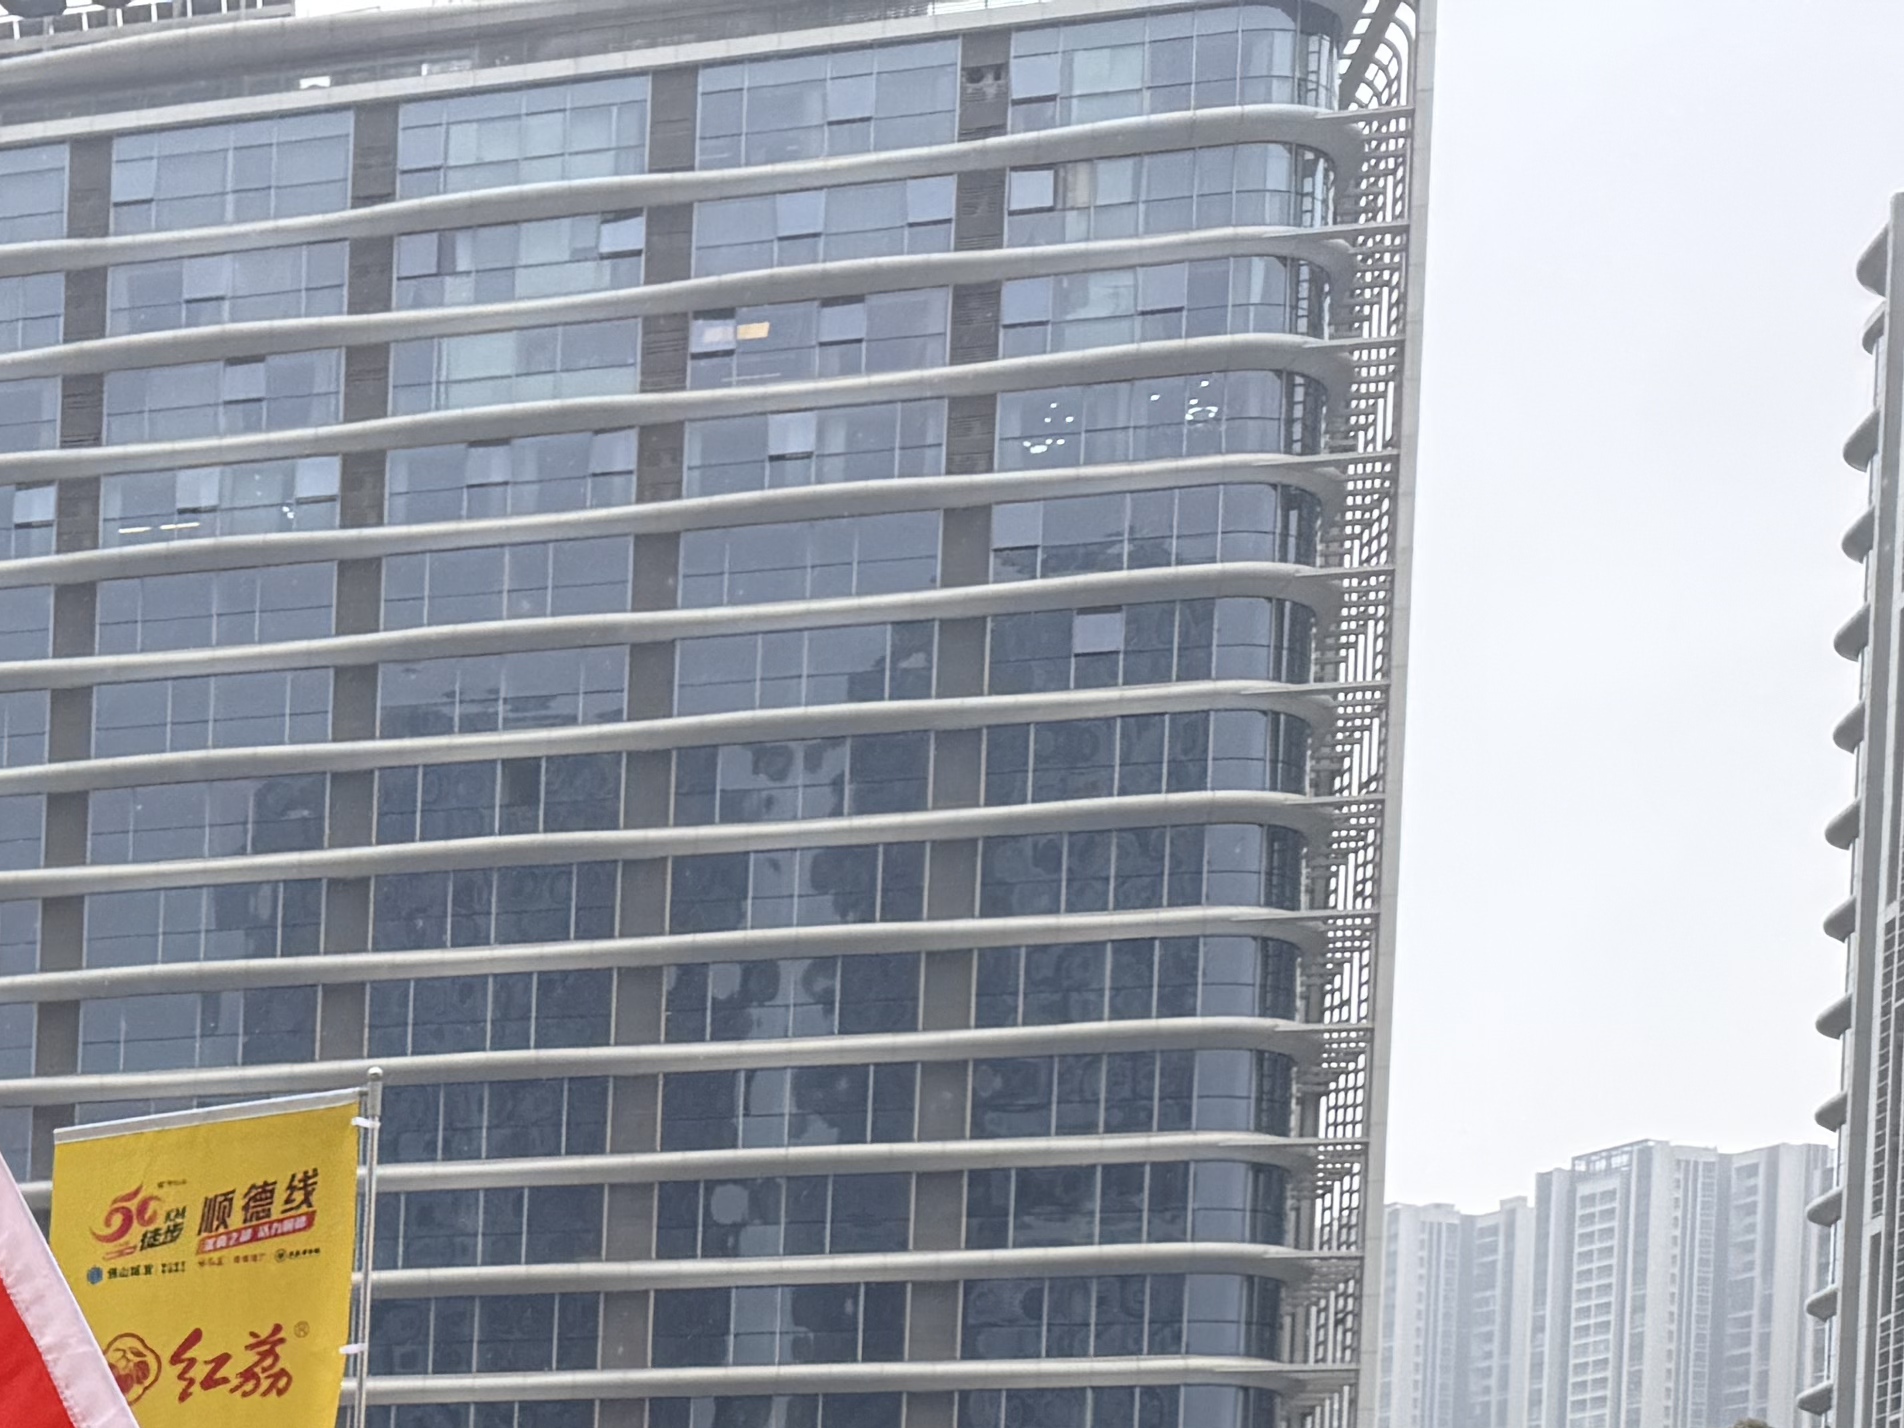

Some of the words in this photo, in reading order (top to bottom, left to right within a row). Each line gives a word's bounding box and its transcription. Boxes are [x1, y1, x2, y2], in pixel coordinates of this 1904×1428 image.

[197, 1167, 319, 1237] 顺德线
[167, 1319, 294, 1403] 红荔
